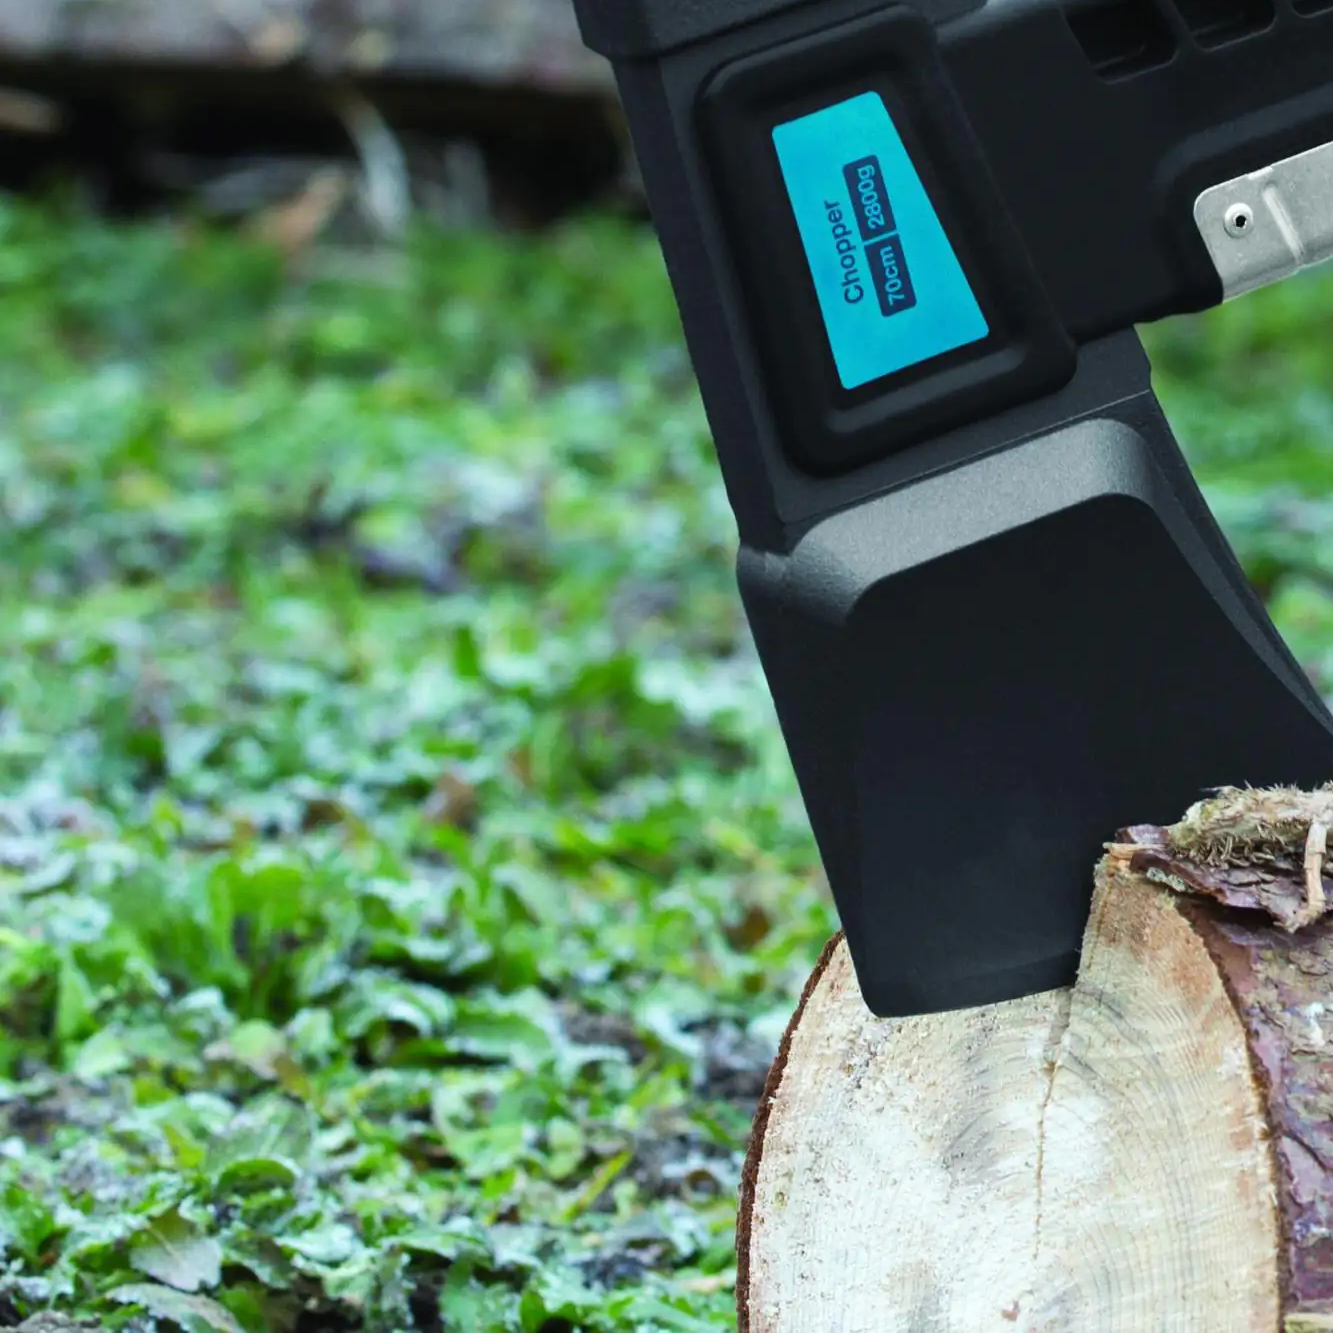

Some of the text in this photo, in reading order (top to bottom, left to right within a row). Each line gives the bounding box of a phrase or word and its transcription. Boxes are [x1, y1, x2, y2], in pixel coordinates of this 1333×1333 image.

[824, 199, 865, 305] Chopper
[857, 164, 905, 307] 70cm 2800g
